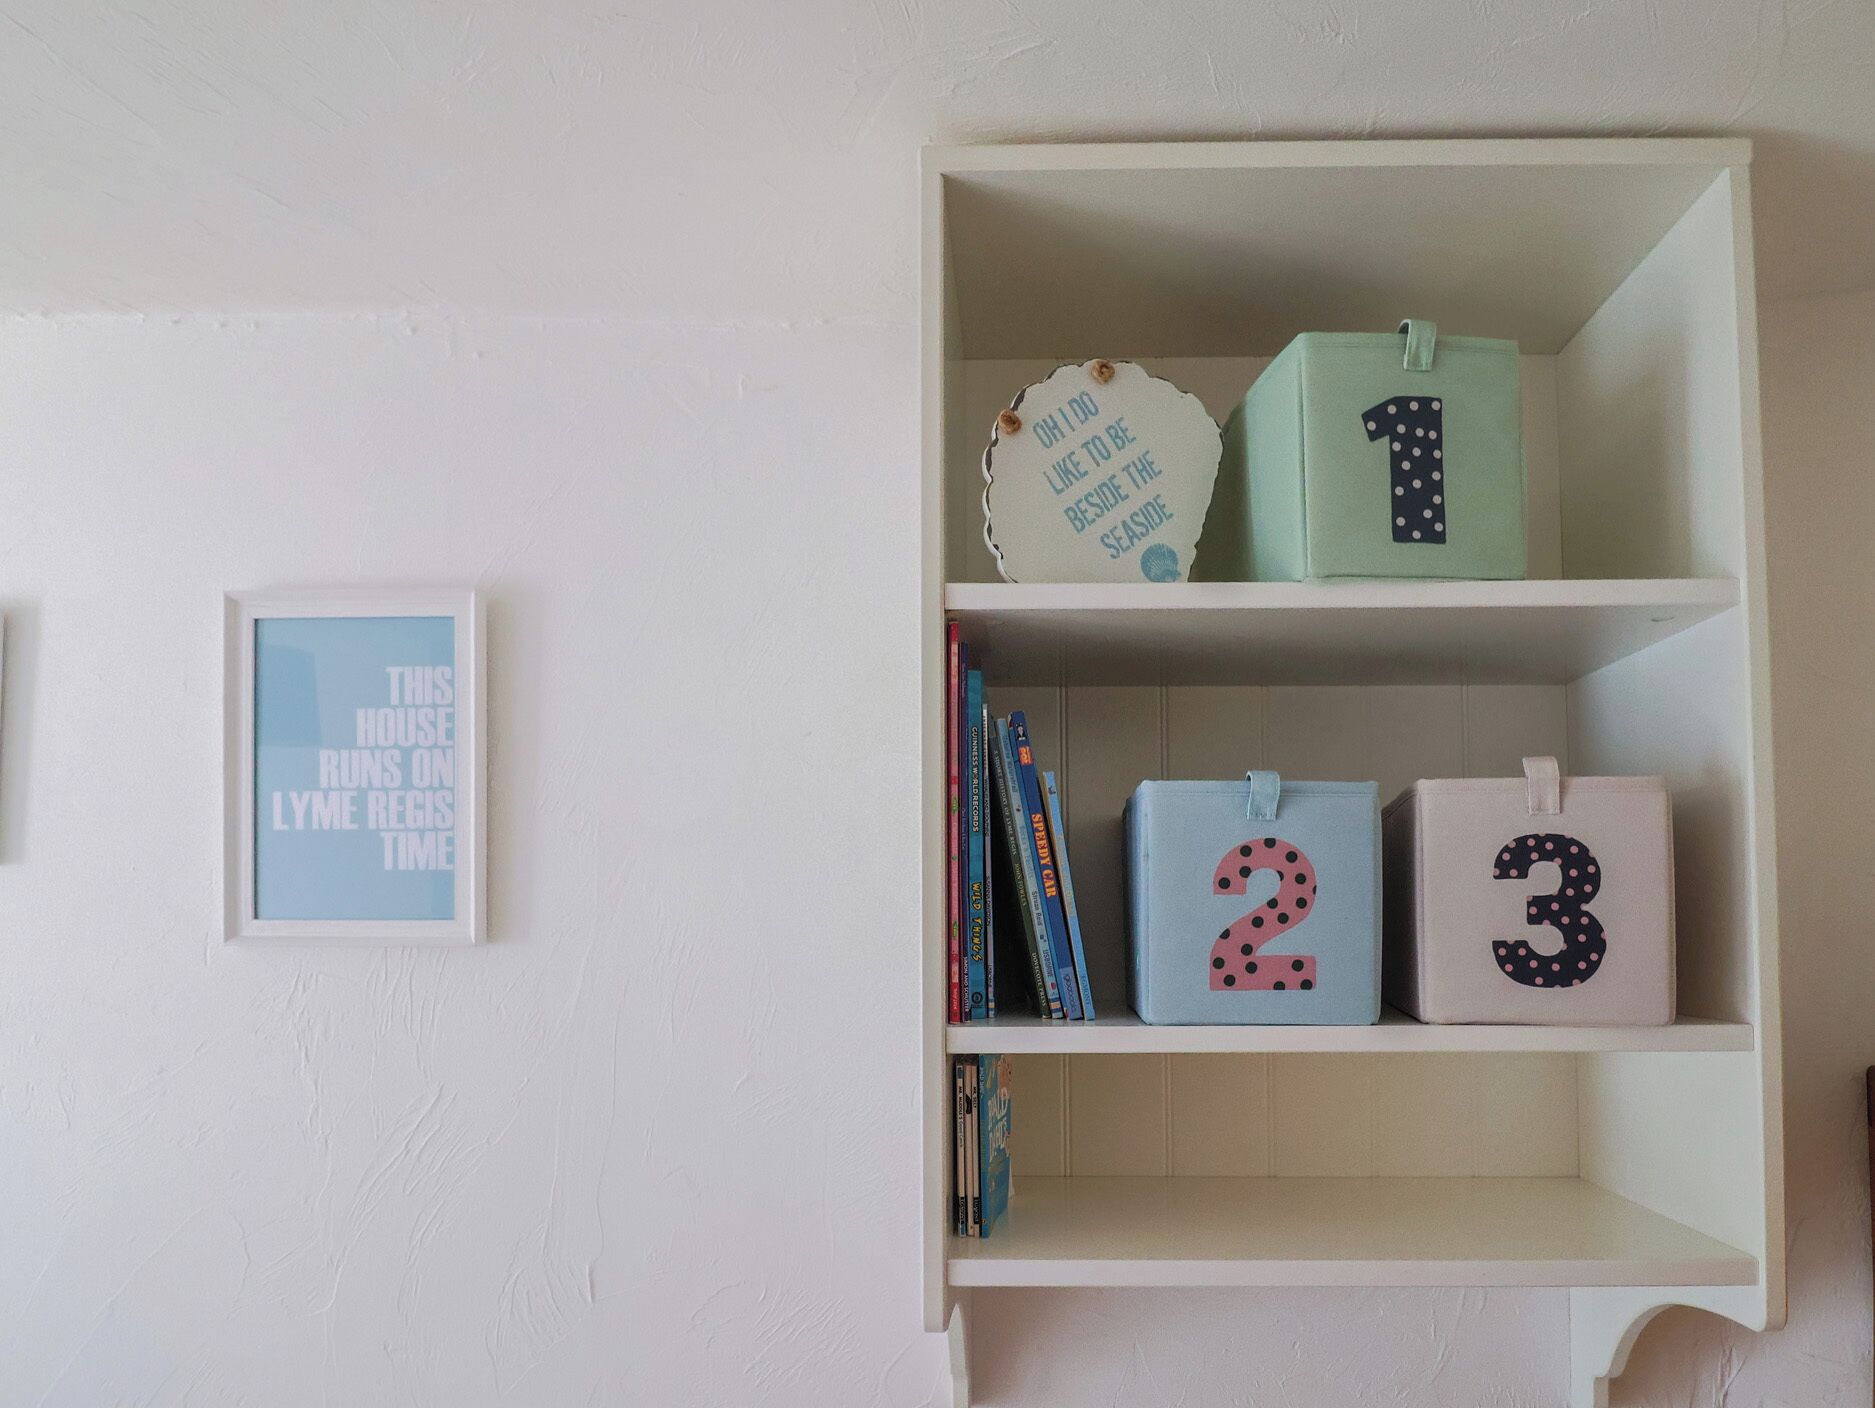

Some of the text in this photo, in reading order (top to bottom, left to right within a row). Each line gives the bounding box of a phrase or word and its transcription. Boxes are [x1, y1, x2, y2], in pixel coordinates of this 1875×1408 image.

[1032, 391, 1099, 449] OH I DO
[1043, 417, 1136, 496] LIKE TO BE
[1361, 396, 1446, 544] 1
[1063, 451, 1162, 534] BESIDE THE
[1100, 494, 1174, 559] SEASIDE
[386, 666, 453, 706] THIS
[356, 707, 454, 747] HOUSE
[319, 749, 454, 789] RUNS ON
[971, 726, 980, 832] GUINNESS WORLD RECORDS
[272, 790, 454, 830] LYME REGIS
[999, 779, 1008, 806] HISTORY
[1005, 817, 1013, 835] LYME
[1009, 835, 1017, 855] REGIS
[380, 832, 454, 870] TIME
[1031, 812, 1057, 898] SPEEDY CAR
[1014, 863, 1027, 906] JOHN FOWLES
[1209, 837, 1317, 990] 2
[1492, 833, 1607, 988] 3
[972, 882, 983, 961] WILD THINGS
[1031, 952, 1047, 1007] DOVECOTE PRESS
[1081, 975, 1090, 1006] EGMONT
